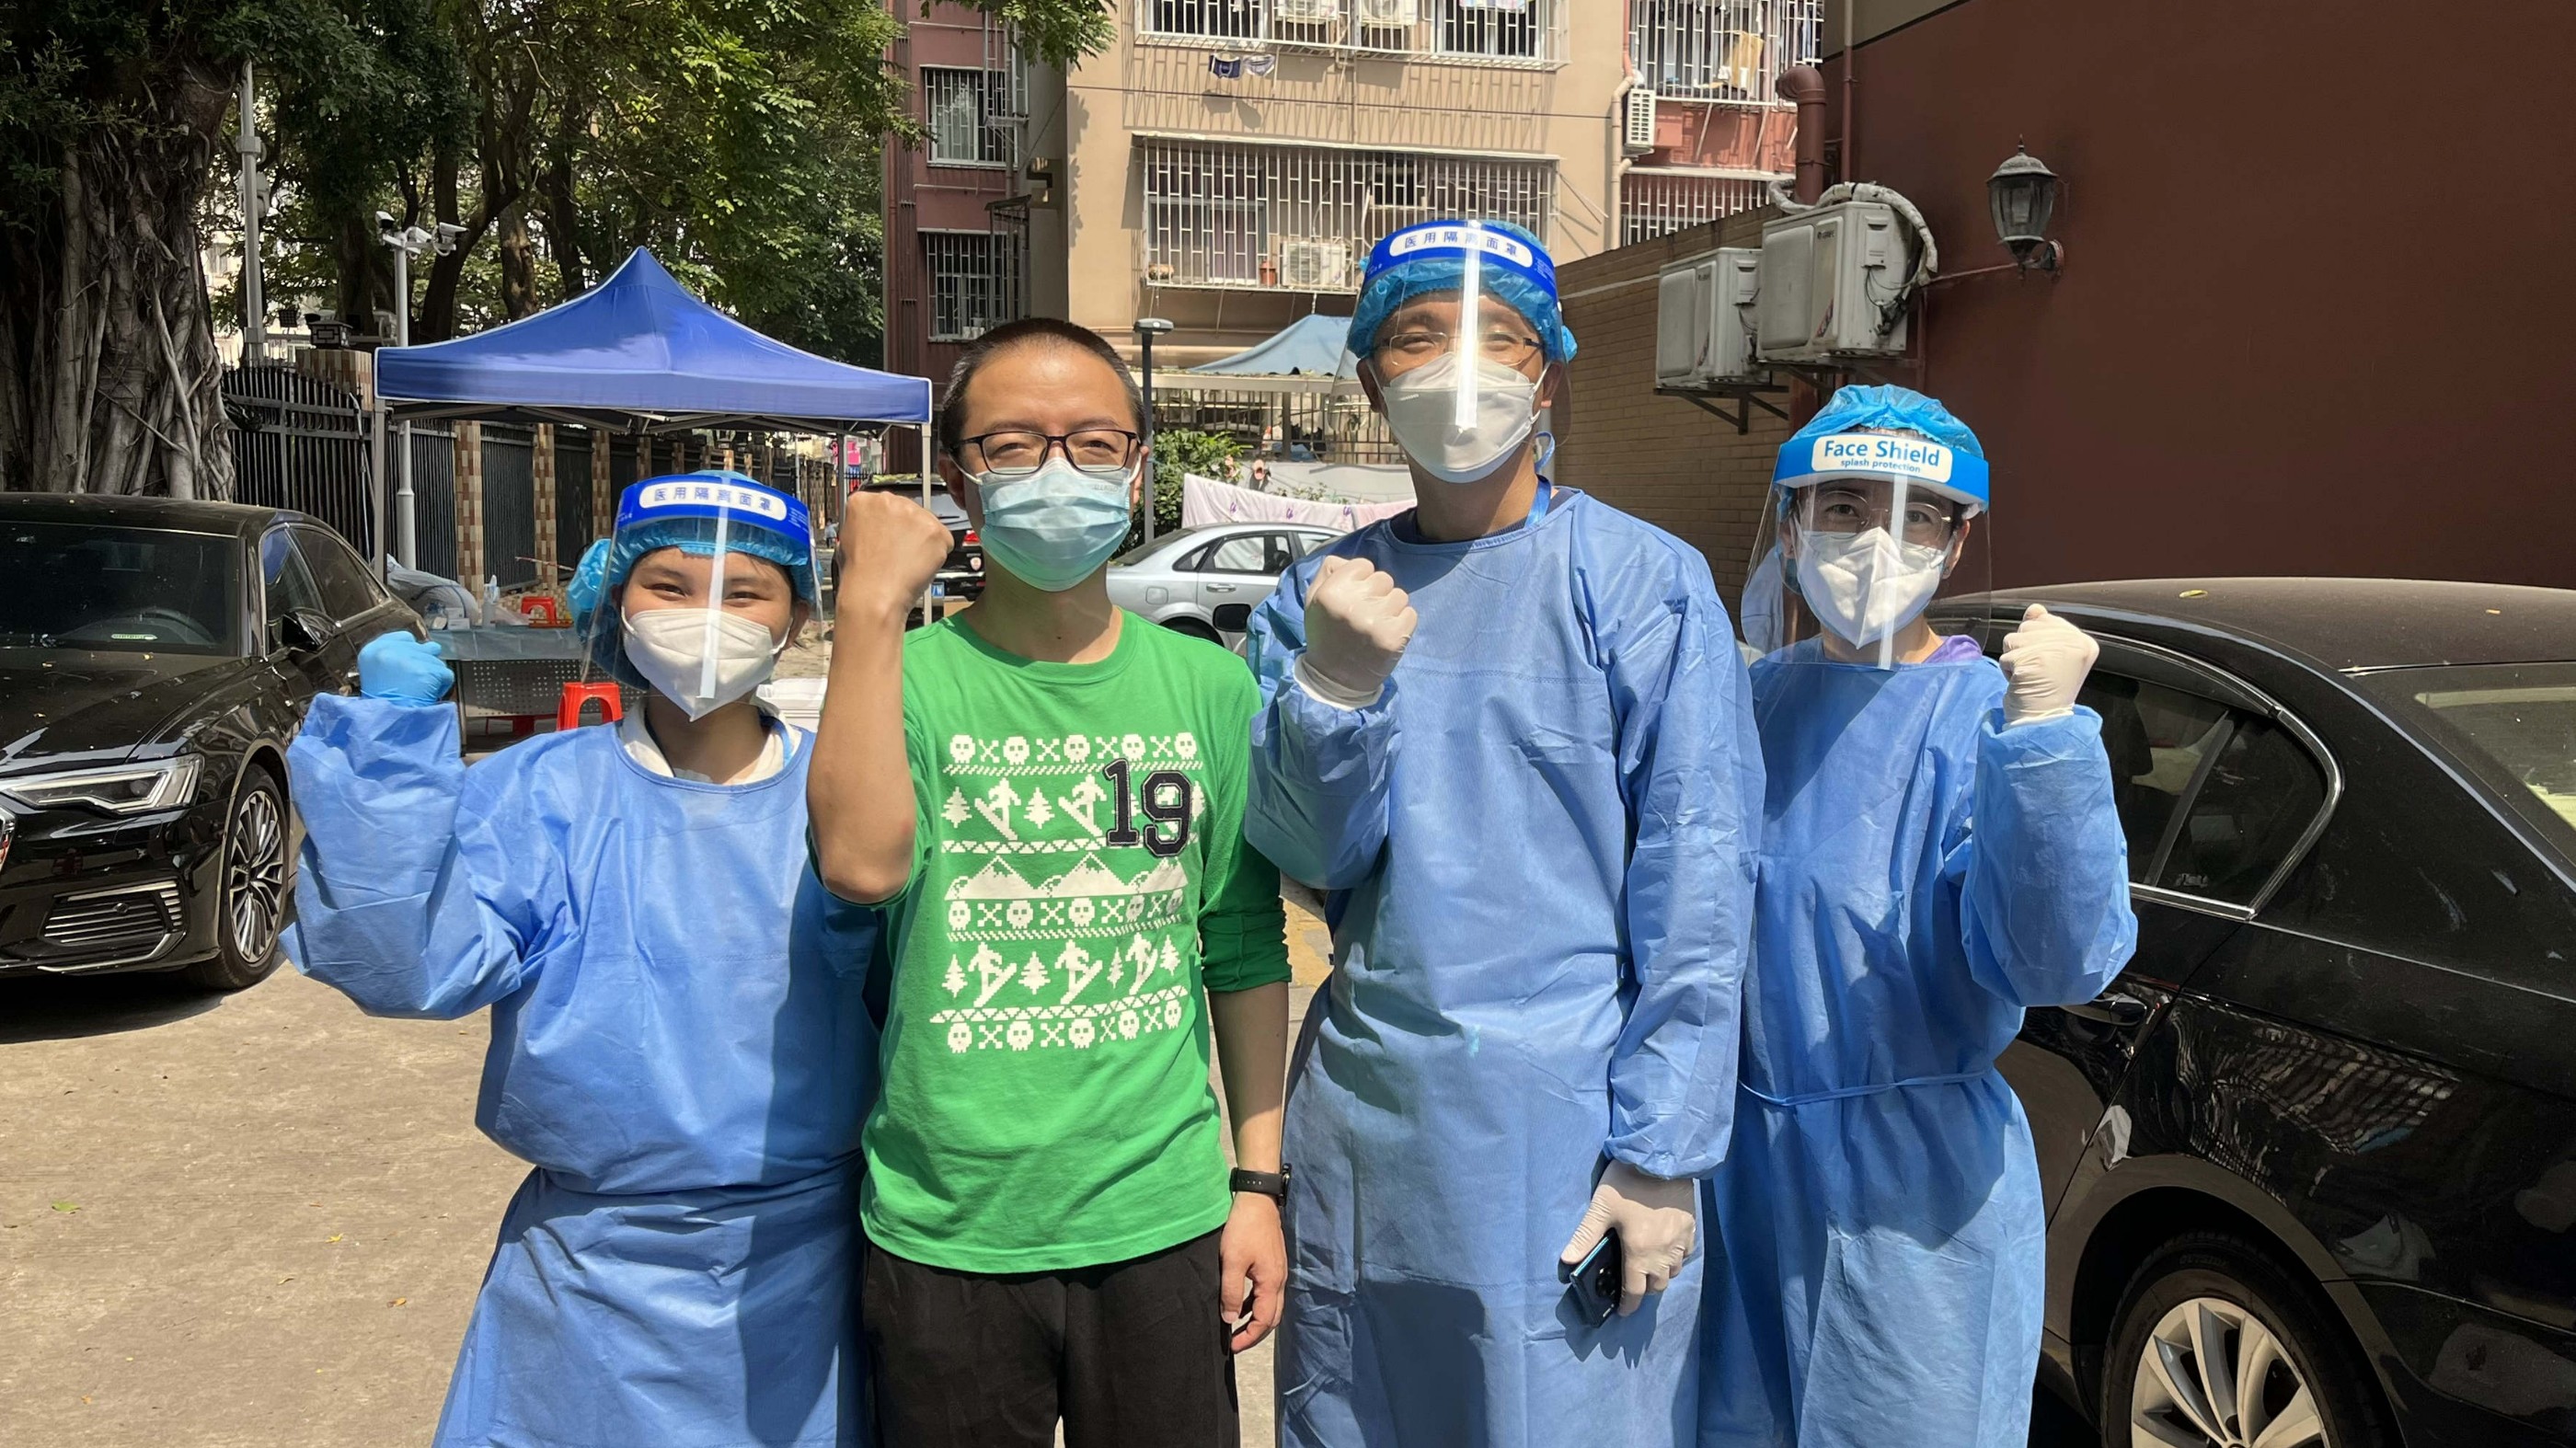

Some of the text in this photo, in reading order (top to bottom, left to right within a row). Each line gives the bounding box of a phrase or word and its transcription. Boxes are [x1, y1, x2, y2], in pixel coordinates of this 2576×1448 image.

[1824, 440, 1940, 466] Face Shield
[1841, 458, 1921, 474] splash protection
[654, 487, 772, 511] 医用隔离面罩
[1103, 757, 1193, 857] 19
